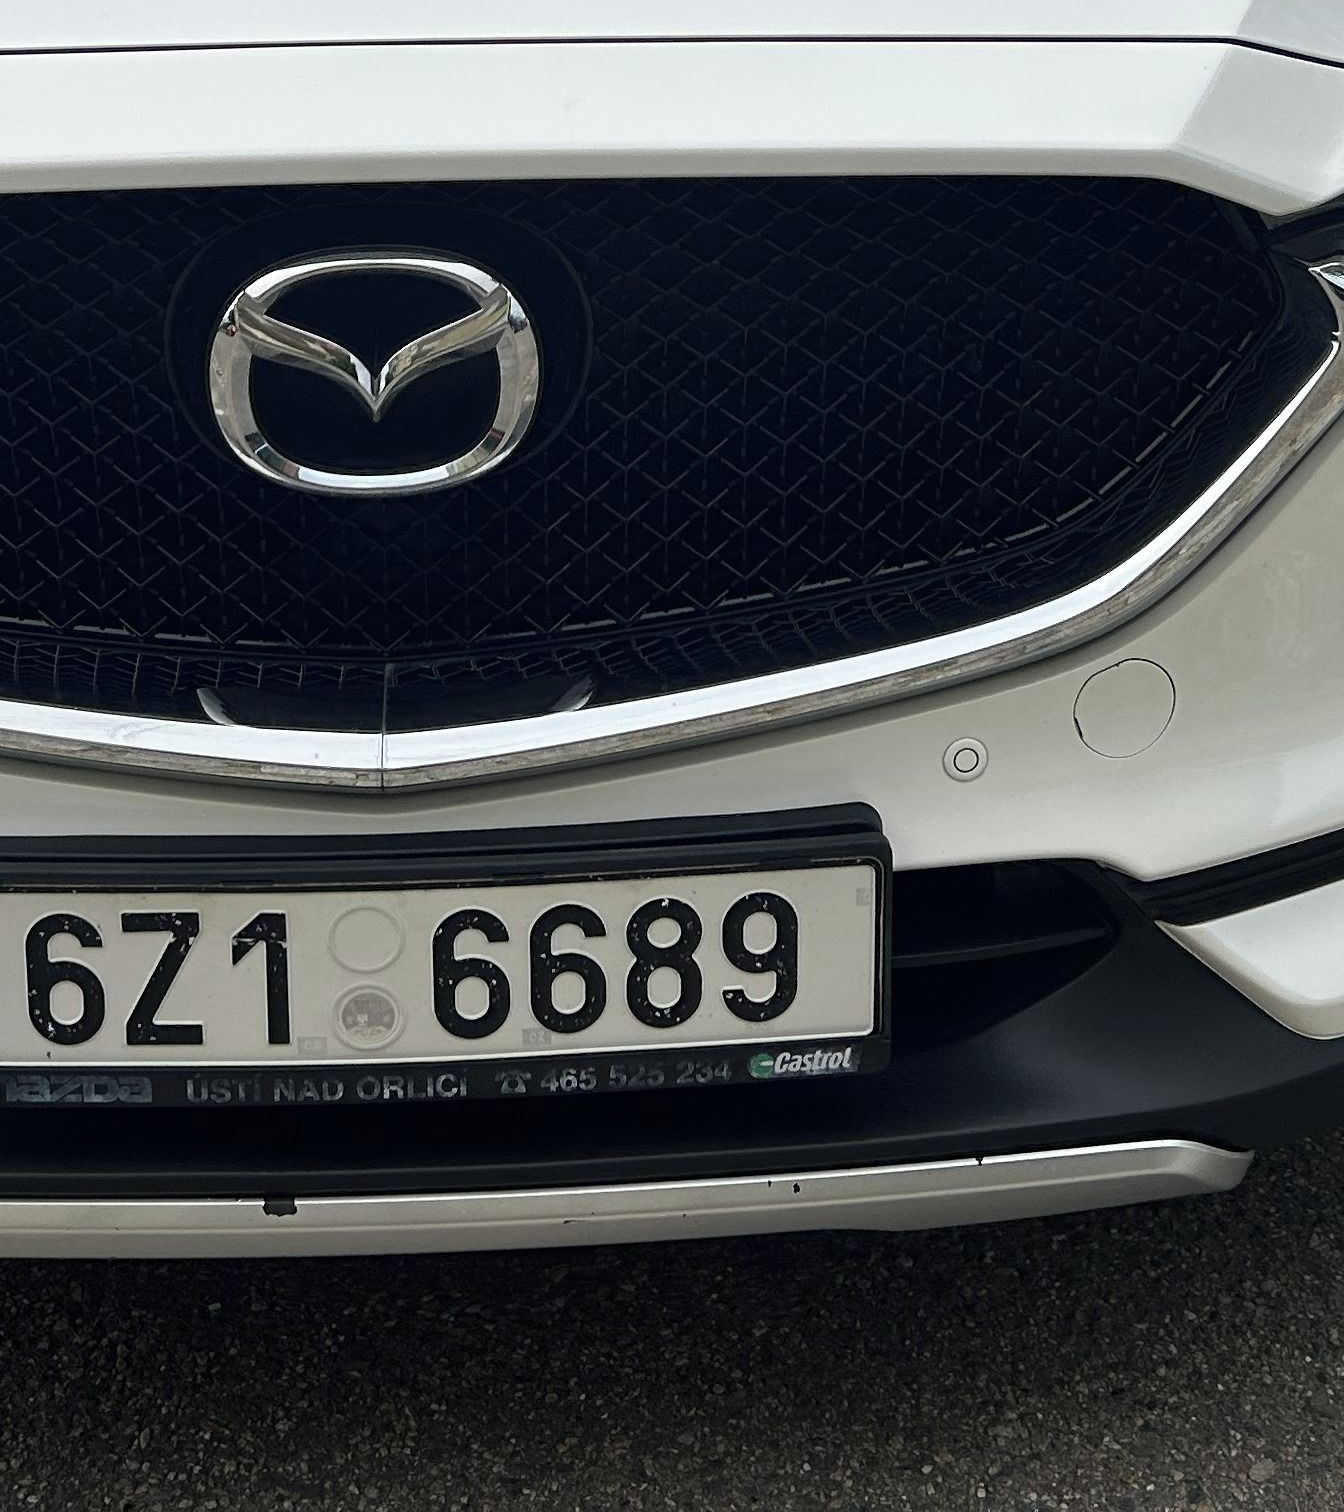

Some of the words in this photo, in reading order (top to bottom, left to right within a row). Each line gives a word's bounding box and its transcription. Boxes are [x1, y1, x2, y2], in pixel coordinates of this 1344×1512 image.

[25, 912, 290, 1046] 6Z1
[431, 892, 798, 1039] 6689
[273, 1078, 344, 1102] NAD
[541, 1067, 597, 1093] 465
[676, 1059, 732, 1085] 234
[774, 1047, 851, 1074] Castrol
